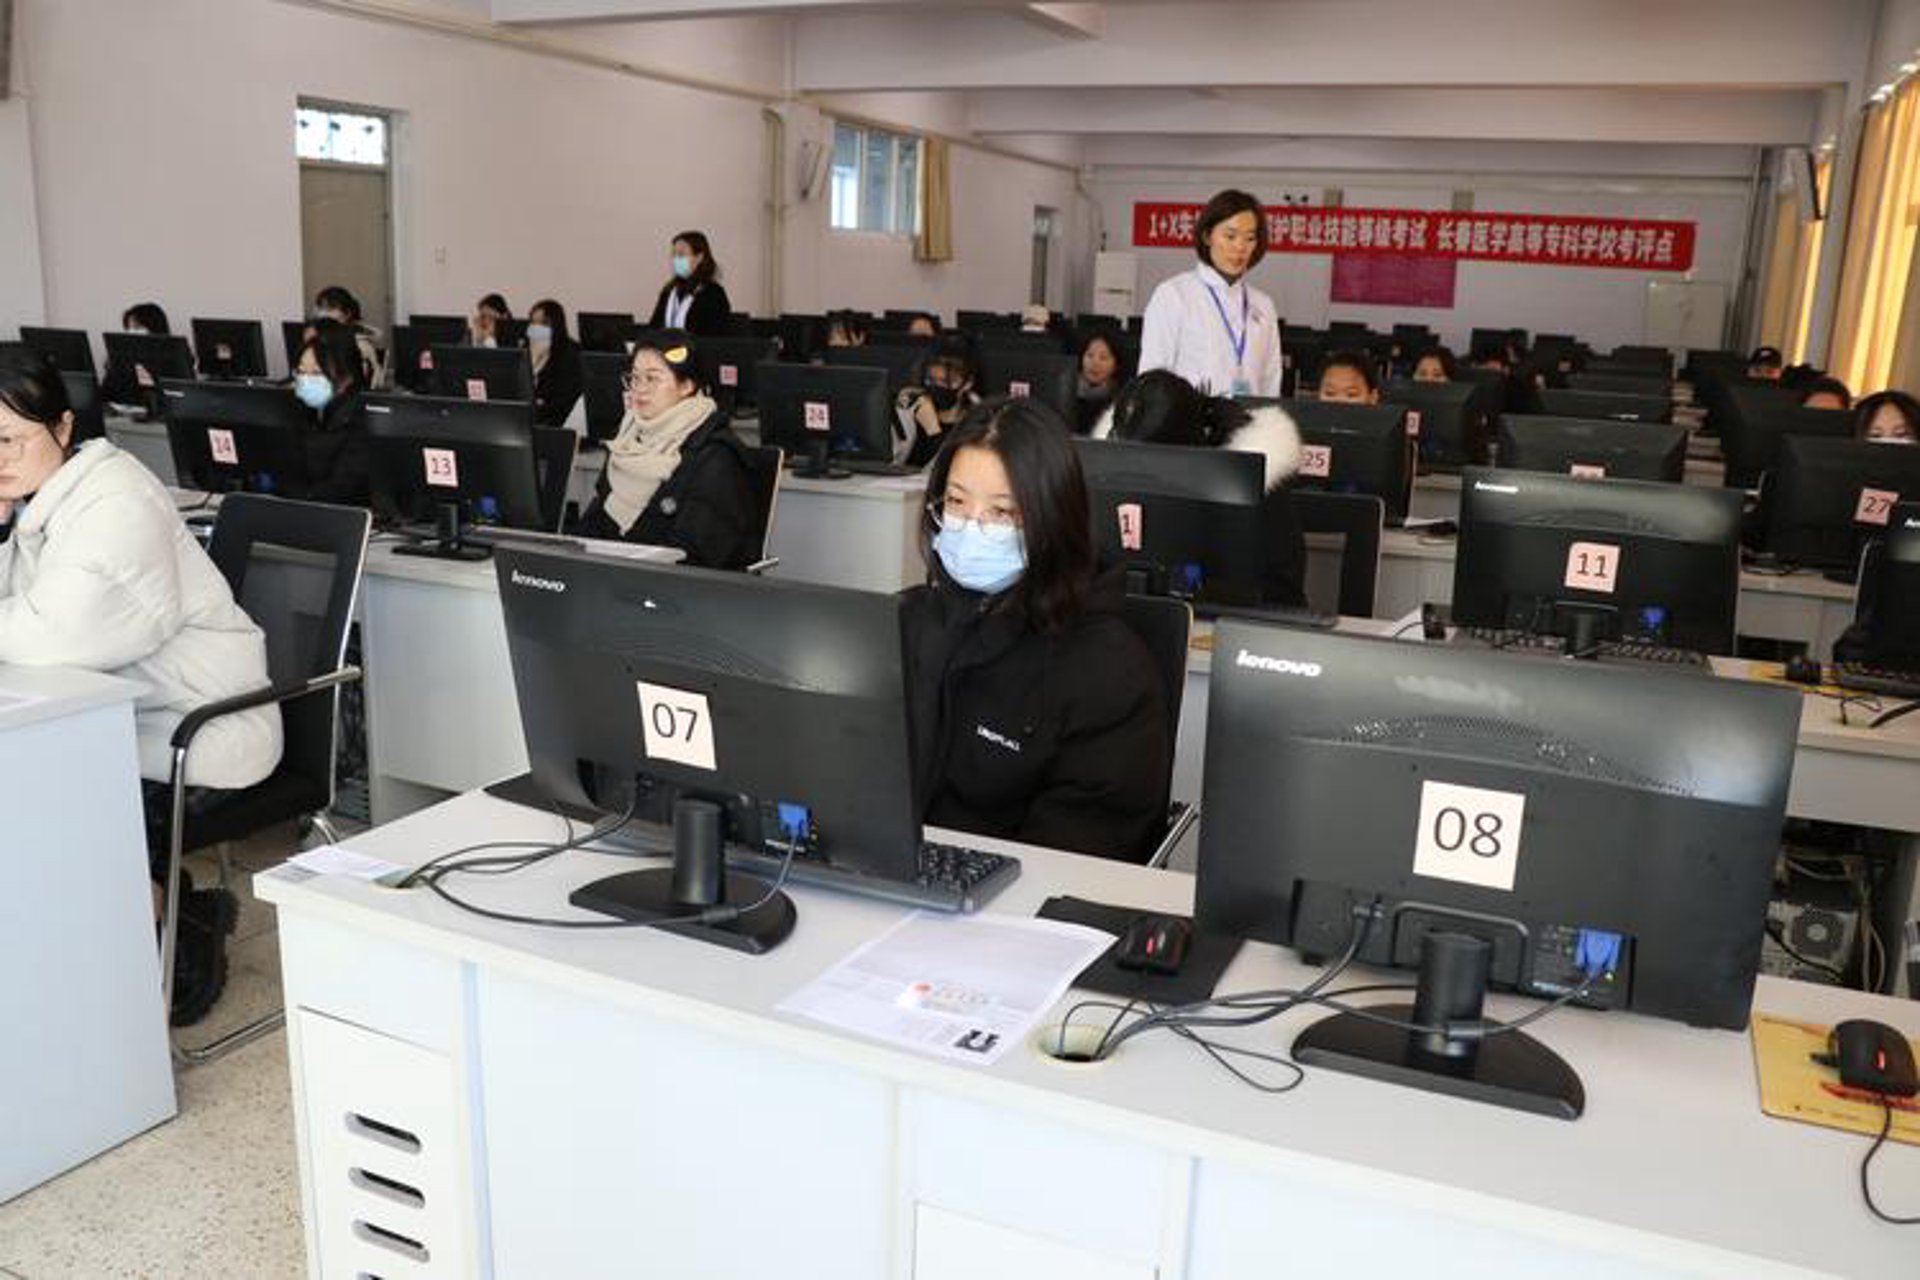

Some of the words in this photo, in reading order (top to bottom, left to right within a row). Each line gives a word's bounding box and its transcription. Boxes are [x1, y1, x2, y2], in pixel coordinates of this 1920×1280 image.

[1148, 210, 1428, 249] 1+X失护职业技能等级考试
[1437, 217, 1676, 263] 长春医学高等专科学校考评点
[431, 457, 452, 476] 13
[1304, 451, 1326, 469] 25
[1863, 496, 1890, 514] 27
[1576, 551, 1608, 579] 11
[511, 568, 566, 593] lenovo
[1236, 648, 1322, 678] lenovo
[652, 701, 698, 742] 07
[1433, 805, 1503, 859] 08
